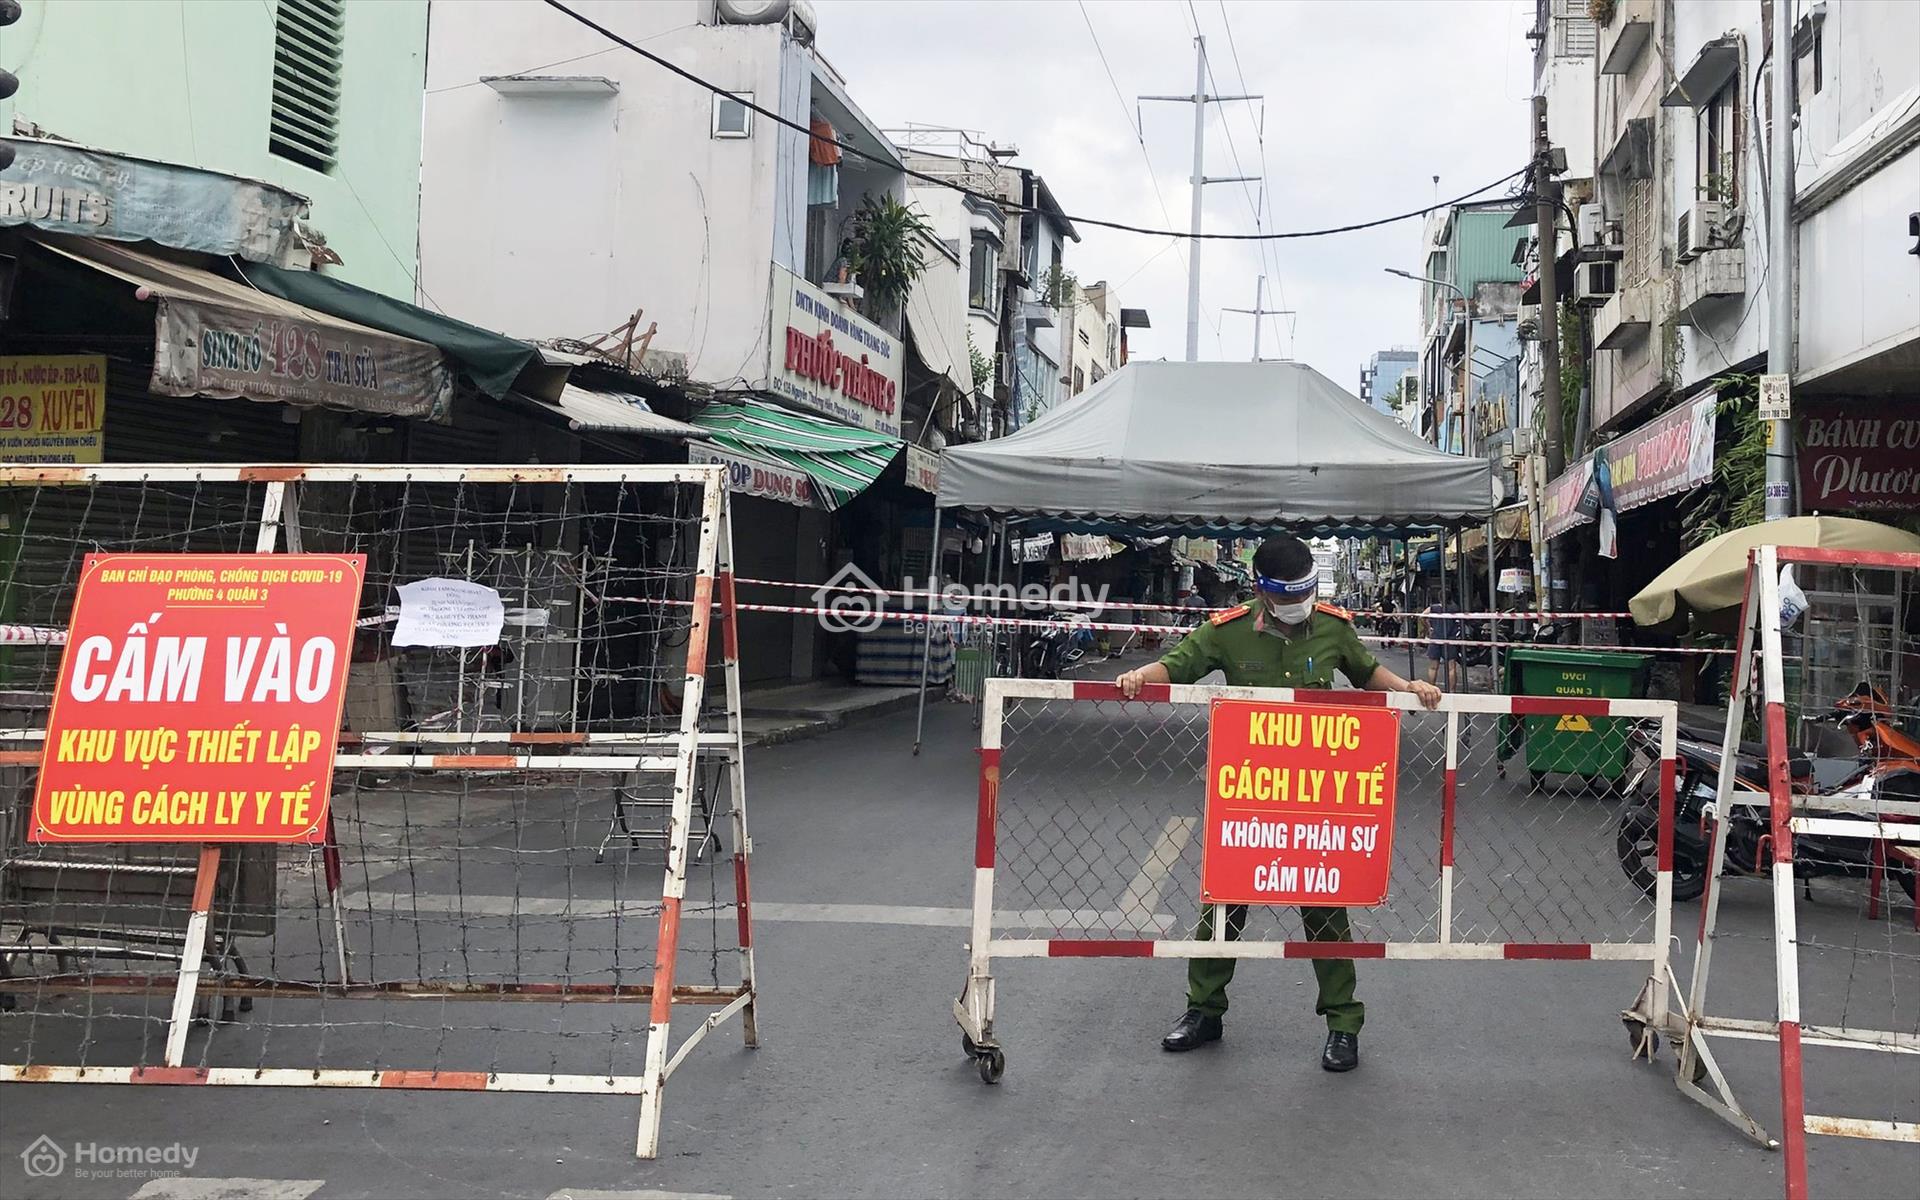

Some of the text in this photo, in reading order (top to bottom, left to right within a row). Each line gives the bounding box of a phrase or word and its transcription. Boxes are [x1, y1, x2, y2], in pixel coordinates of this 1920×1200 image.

[203, 329, 240, 371] SINH
[240, 321, 263, 374] TỐ
[325, 342, 352, 387] TRÀ
[353, 345, 379, 392] SỮA
[785, 326, 843, 391] PHƯỚC
[841, 353, 888, 412] THÀNH
[1806, 411, 1881, 448] BÁNH
[100, 565, 343, 586] BAN CHỈ ĐẠO PHÒNG, CHỐNG DỊCH COVID-19
[167, 584, 268, 604] PHƯỜNG 4 QUẬN 3
[70, 610, 336, 703] CẤM VÀO
[1562, 671, 1586, 681] DVCI
[1586, 687, 1593, 695] 3
[57, 720, 322, 770] KHU VỰC THIẾT LẬP
[1249, 711, 1362, 756] KHU VỰC
[49, 780, 316, 825] VÙNG CÁCH LY Y TẾ
[1218, 759, 1388, 806] CÁCH LY Y TẾ
[1220, 816, 1379, 858] KHÔNG PHẬN SỰ
[1253, 857, 1340, 894] CẤM VÀO
